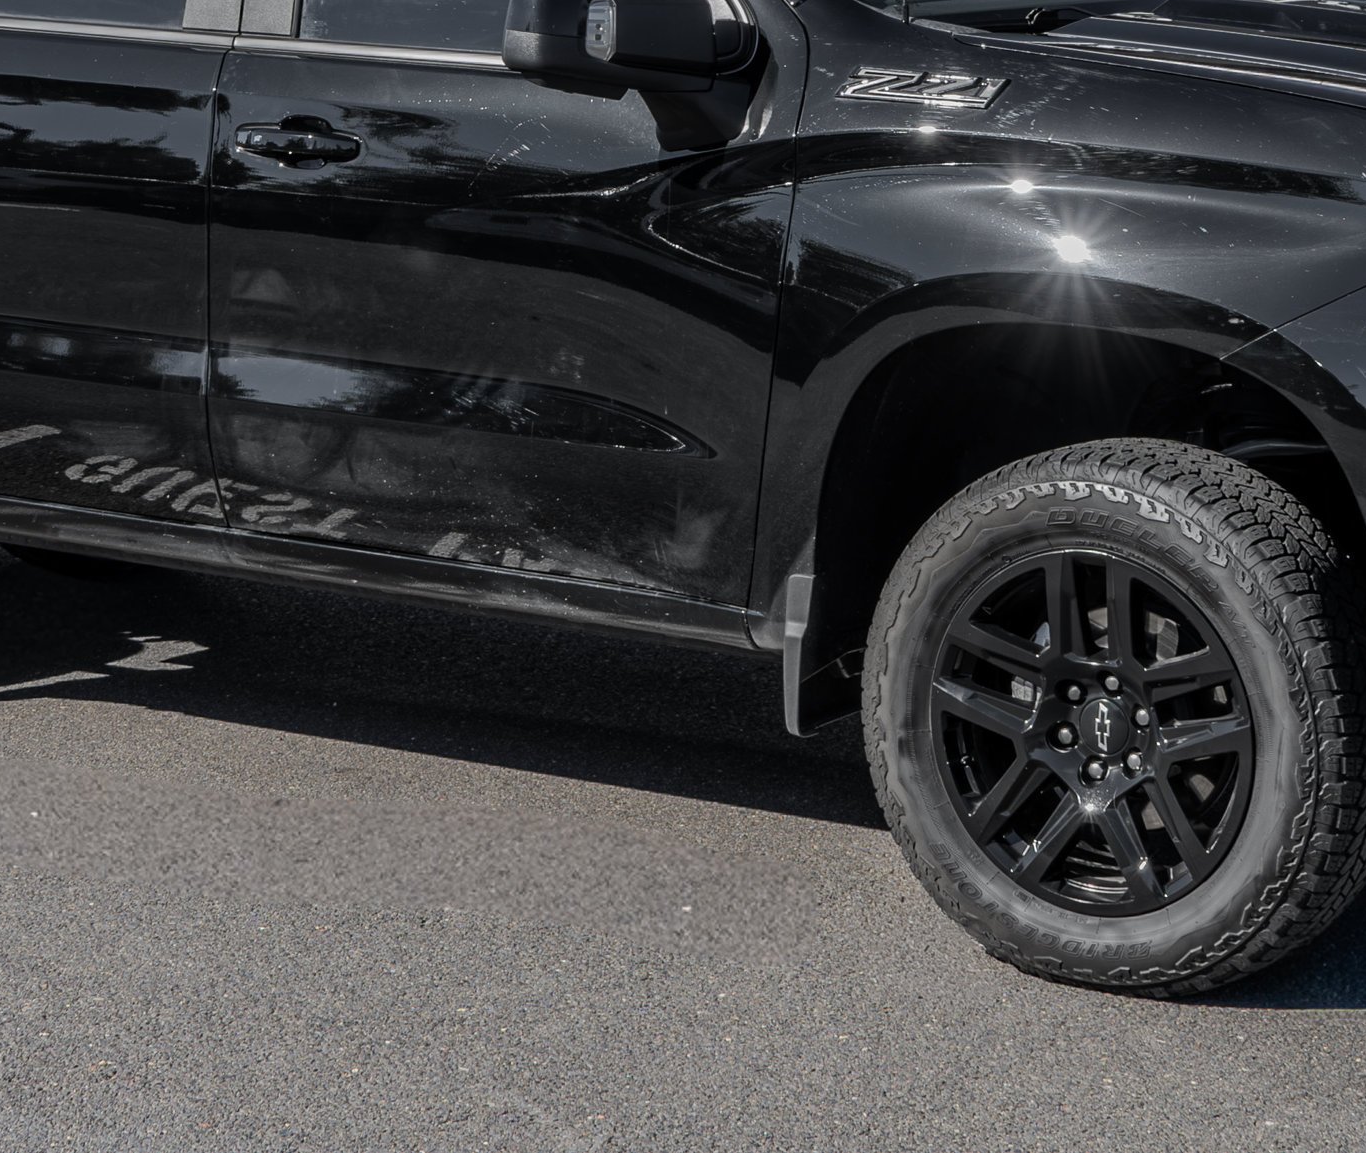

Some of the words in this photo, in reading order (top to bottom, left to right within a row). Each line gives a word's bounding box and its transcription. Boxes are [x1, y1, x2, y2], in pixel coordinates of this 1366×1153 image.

[835, 66, 1012, 110] Z71
[1045, 506, 1219, 593] DUELER
[930, 842, 1153, 961] BRIDGESTONE
